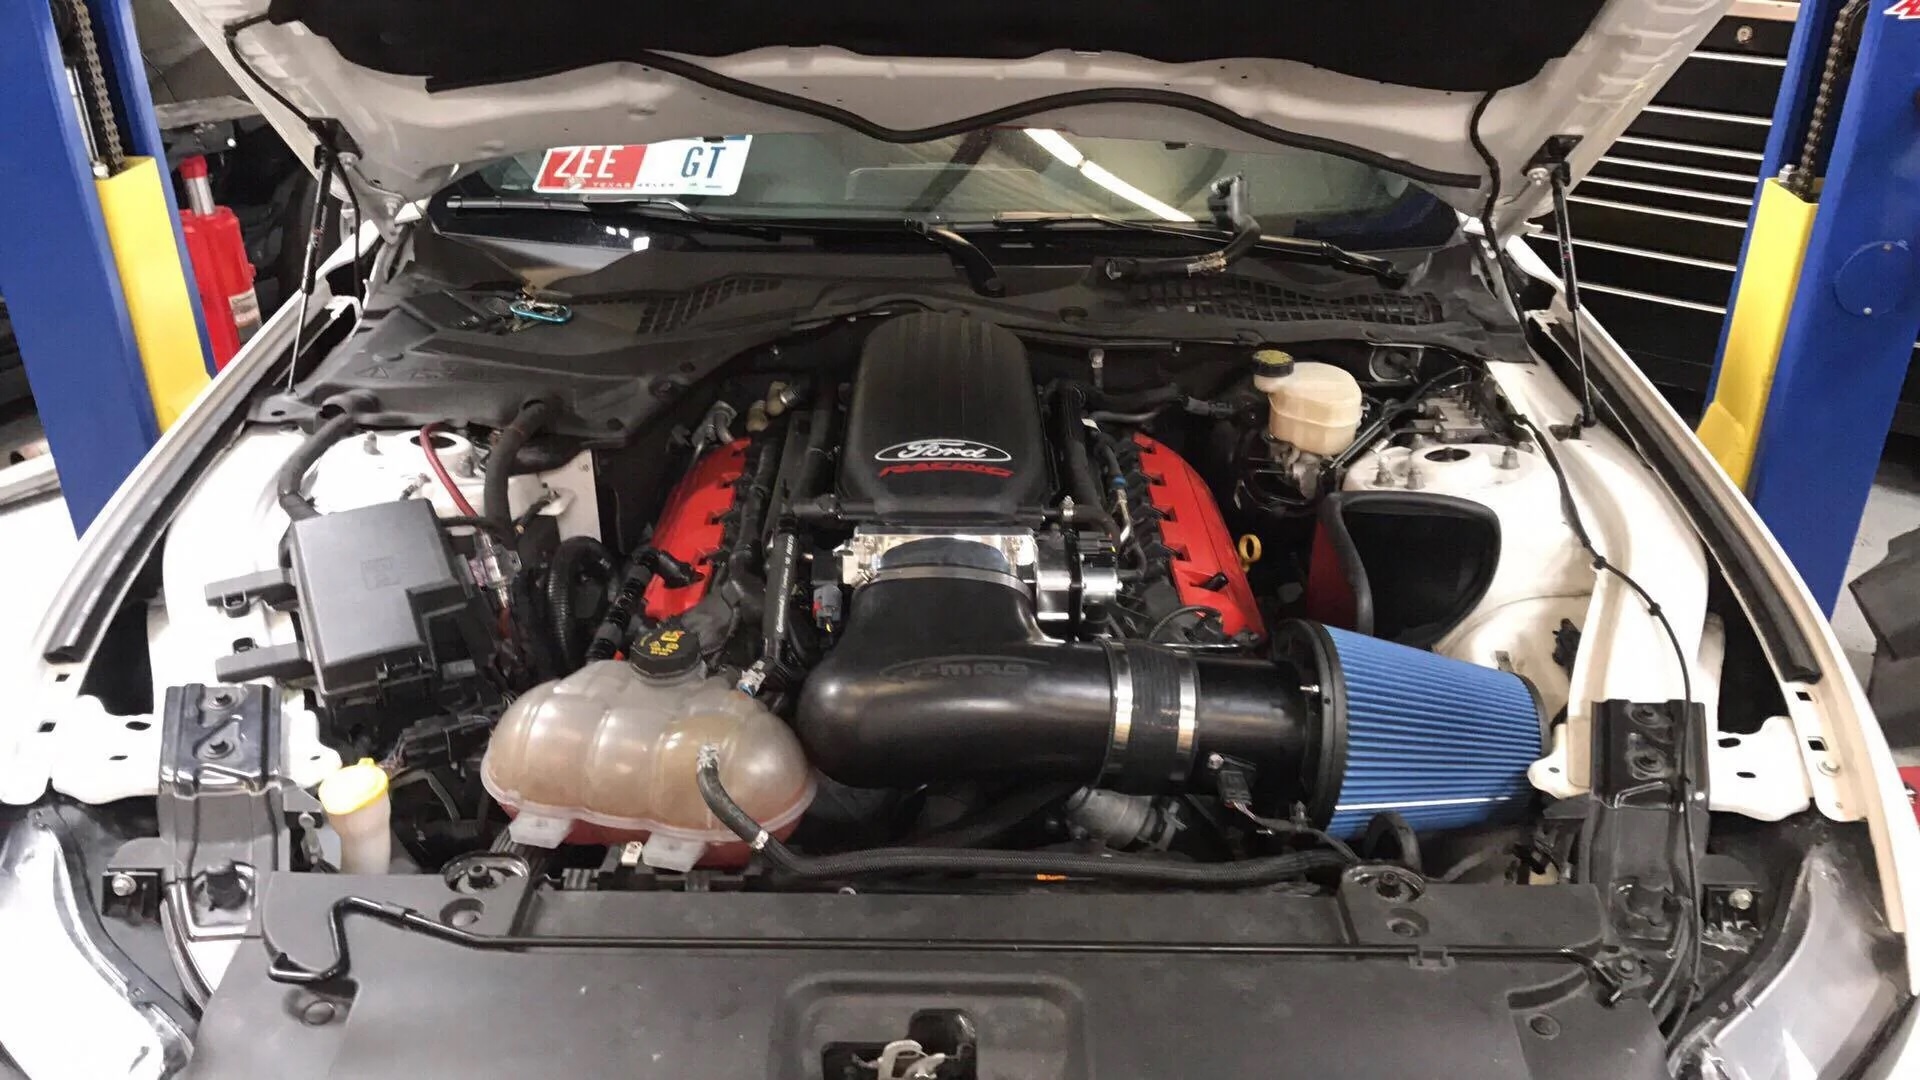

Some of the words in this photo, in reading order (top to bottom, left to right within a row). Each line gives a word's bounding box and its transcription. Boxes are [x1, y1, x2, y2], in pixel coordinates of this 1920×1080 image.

[554, 146, 622, 179] ZEE
[681, 146, 727, 179] GT
[897, 441, 988, 459] Ford
